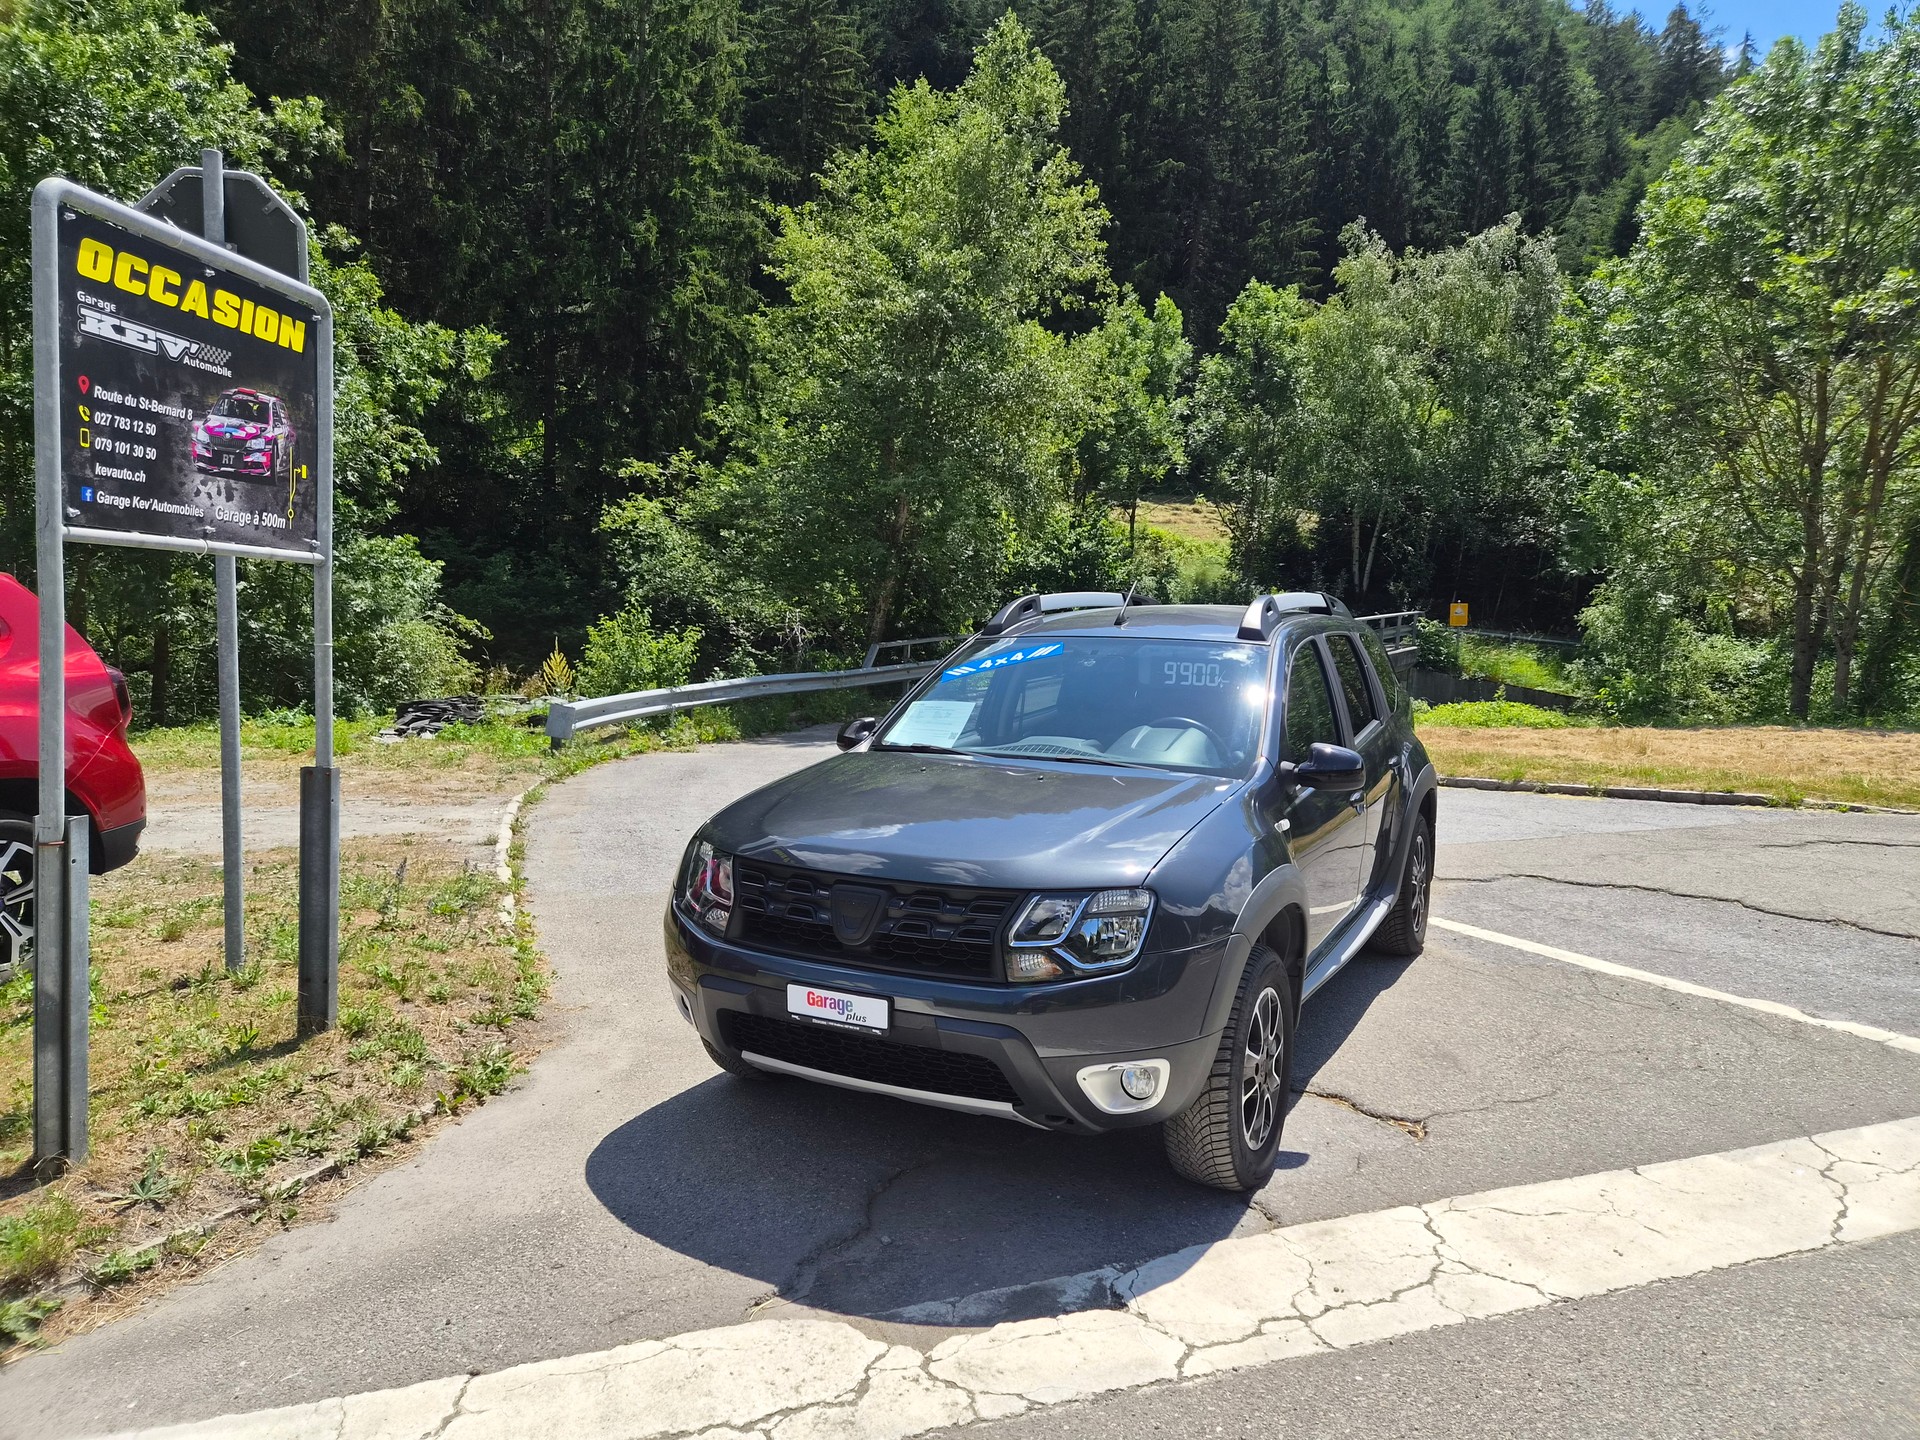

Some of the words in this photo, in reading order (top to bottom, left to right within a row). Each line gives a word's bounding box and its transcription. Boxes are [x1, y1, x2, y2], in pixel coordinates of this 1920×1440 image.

[77, 237, 306, 353] OCCASION
[77, 290, 116, 313] Garage
[183, 355, 232, 378] Automobile
[94, 385, 123, 404] Route
[124, 394, 137, 407] du
[139, 397, 187, 421] St-Bernard
[187, 409, 193, 421] 8
[94, 411, 112, 428] 027
[114, 416, 131, 431] 783
[132, 420, 144, 434] 12
[145, 424, 157, 436] 50
[94, 437, 112, 453] 079
[114, 442, 130, 455] 101
[132, 445, 144, 458] 30
[145, 448, 157, 461] 50
[222, 453, 235, 465] RT
[95, 462, 146, 483] kevauto.ch
[96, 491, 131, 510] Garage
[132, 496, 204, 518] Kev'Automobiles
[215, 505, 252, 527] Garage
[253, 510, 260, 525] à
[261, 512, 286, 529] 500m
[979, 652, 1024, 669] 4x4
[807, 991, 853, 1015] Garage
[845, 1012, 867, 1023] plus
